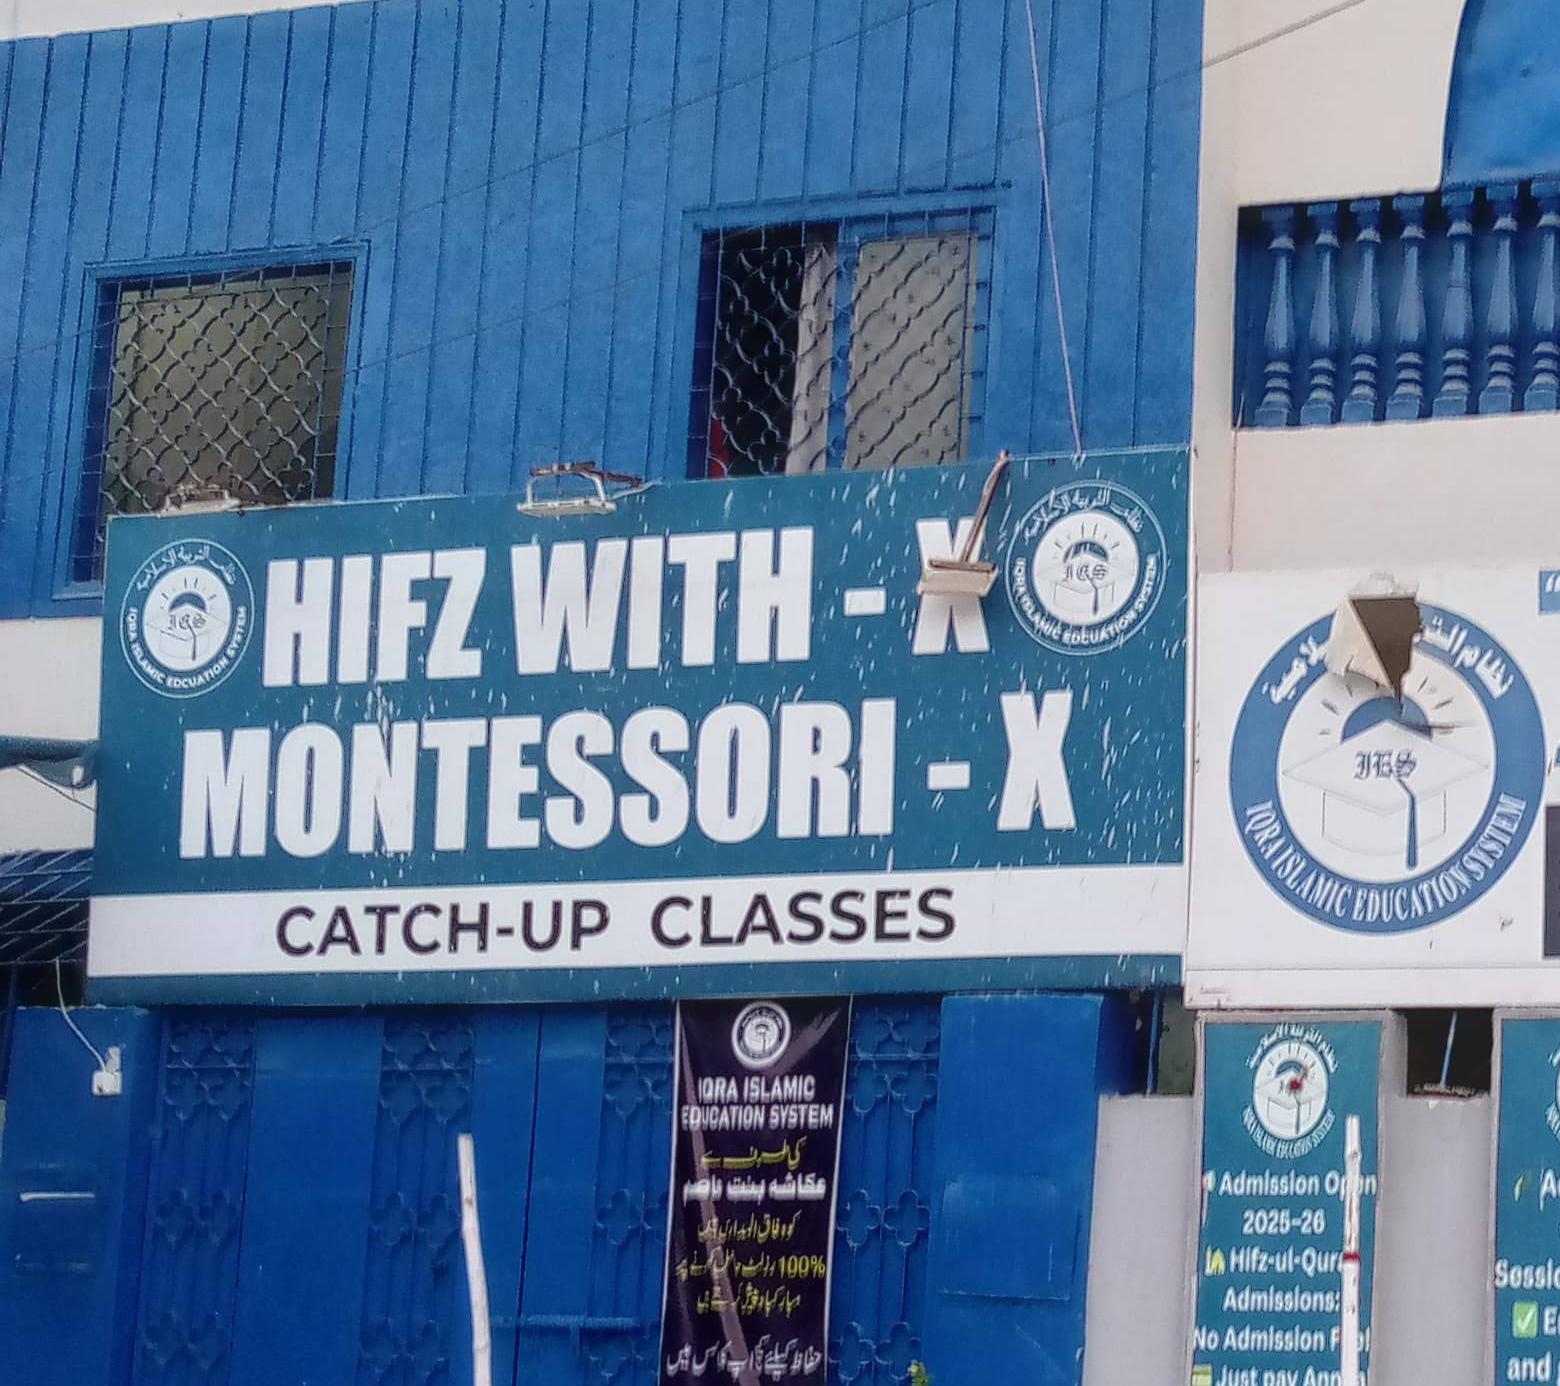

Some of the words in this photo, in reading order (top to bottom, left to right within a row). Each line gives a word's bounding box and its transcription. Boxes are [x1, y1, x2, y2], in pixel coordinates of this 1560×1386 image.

[262, 547, 486, 688] HIFZ
[510, 525, 812, 676] WITH
[910, 516, 994, 655] X
[127, 607, 139, 641] IQRA
[226, 606, 247, 656] SYSTEM
[132, 643, 165, 684] ISLAMIC
[178, 696, 897, 860] MONTESSORI
[996, 688, 1078, 833] X
[1245, 800, 1280, 857] IQRA
[1278, 843, 1353, 918] ISLAMIC
[1352, 865, 1469, 923] EDUCATION
[1461, 792, 1528, 881] SYSTEM
[275, 898, 613, 959] CATCH-UP
[650, 886, 958, 947] CLASSES
[698, 1076, 738, 1104] IQRA
[743, 1075, 816, 1103] ISLAMIC
[682, 1104, 765, 1132] EDUCATION
[769, 1104, 834, 1130] SYSTEM
[1219, 1169, 1320, 1197] Admission
[778, 1255, 826, 1279] 100%
[1194, 1326, 1217, 1351] No
[1223, 1326, 1324, 1354] Admission
[1506, 1353, 1551, 1383] and
